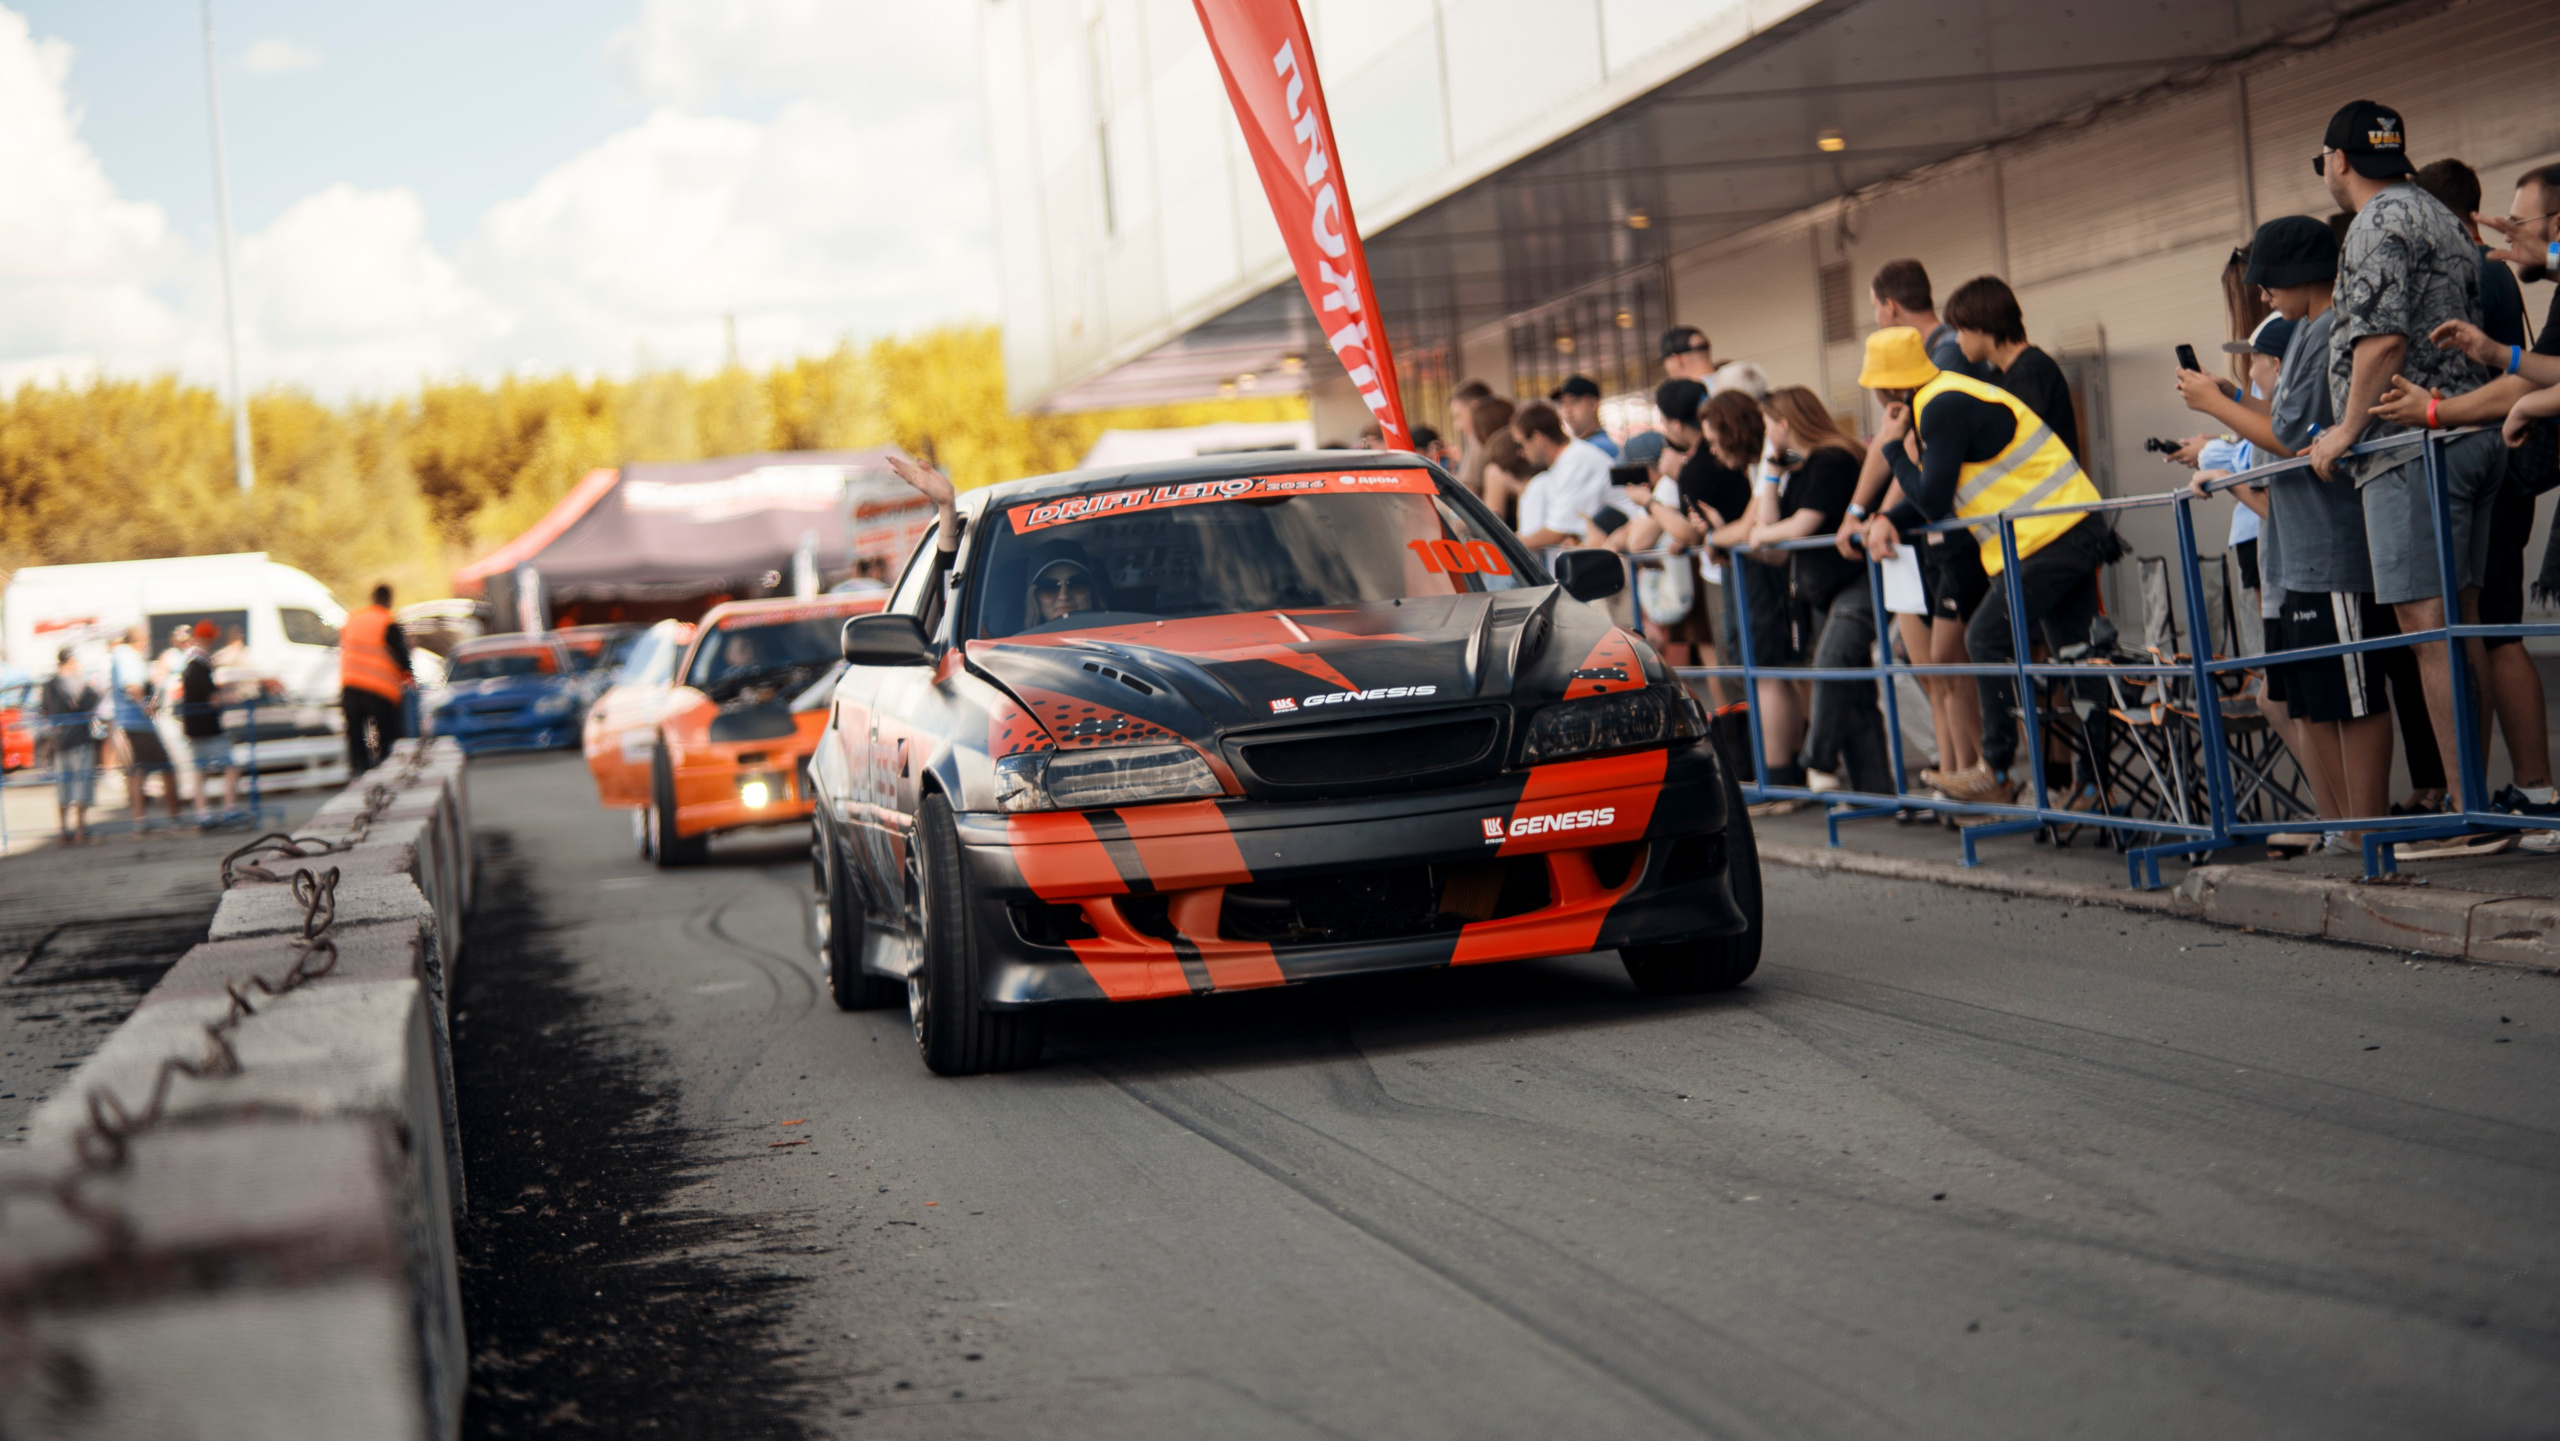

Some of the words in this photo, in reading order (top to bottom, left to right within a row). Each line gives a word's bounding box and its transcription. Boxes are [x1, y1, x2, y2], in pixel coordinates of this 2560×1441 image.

[1027, 488, 1151, 527] DRIFT
[1153, 477, 1254, 503] LETO
[1406, 539, 1512, 576] 100
[1303, 685, 1437, 707] GENESIS
[1509, 807, 1616, 837] GENESIS
